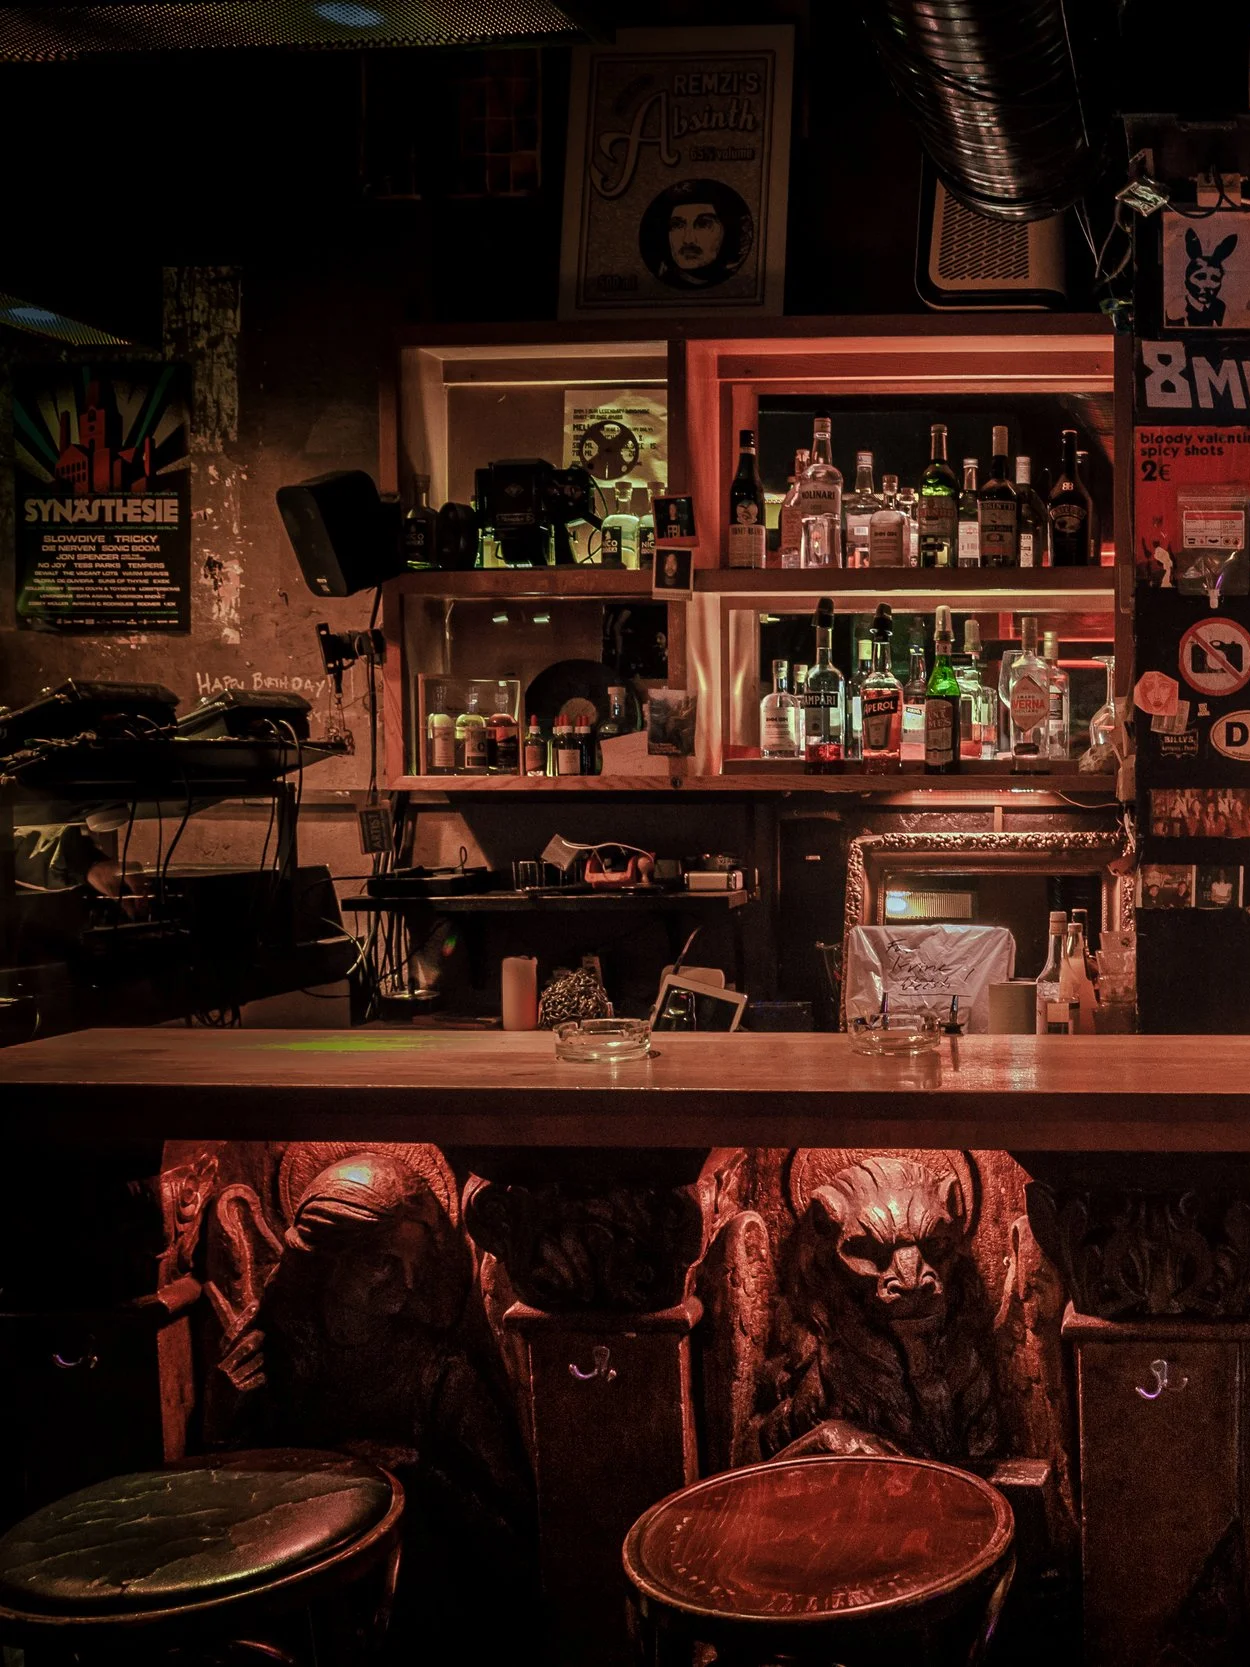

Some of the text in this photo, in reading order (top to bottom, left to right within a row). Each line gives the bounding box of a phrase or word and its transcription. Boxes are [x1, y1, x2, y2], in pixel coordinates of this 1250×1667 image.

[674, 73, 761, 96] REMZI'S
[590, 90, 757, 200] Absinth
[1140, 433, 1193, 445] bloody
[1140, 445, 1224, 458] spicy shots
[1141, 460, 1171, 482] 2€
[43, 535, 158, 543] SLOWDIVE TRICKY
[864, 701, 895, 717] APEROL
